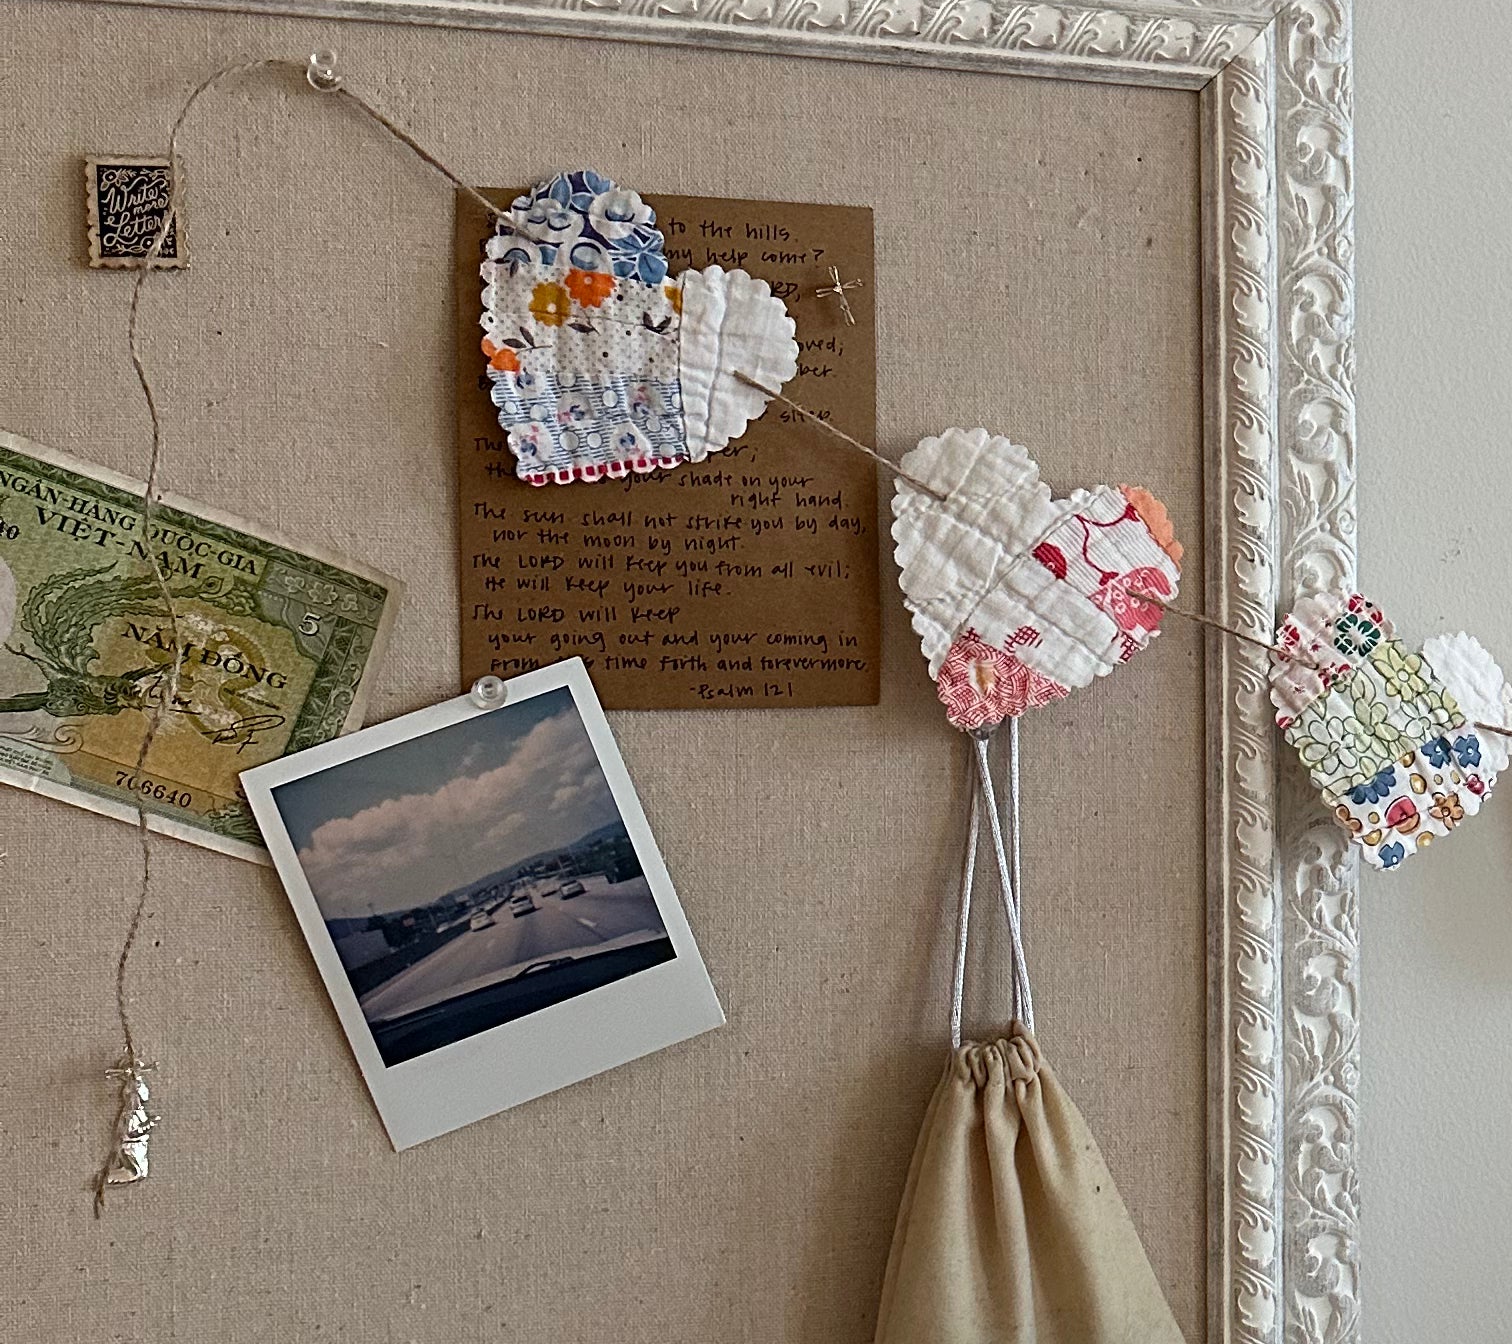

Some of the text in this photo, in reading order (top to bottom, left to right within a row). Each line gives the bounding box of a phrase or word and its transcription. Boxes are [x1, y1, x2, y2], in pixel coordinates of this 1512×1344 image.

[101, 176, 167, 213] Write
[134, 192, 168, 215] more
[669, 218, 798, 242] to the hills.
[707, 247, 748, 265] help
[761, 249, 824, 264] come?
[621, 470, 814, 495] your shade on your
[731, 490, 848, 510] right hand.
[474, 502, 866, 535] The sun shall not strike you by day,
[493, 529, 745, 556] nor the moon by night.
[473, 554, 501, 569] The
[519, 554, 564, 570] LORD
[578, 554, 613, 570] will
[676, 560, 708, 577] you
[716, 560, 762, 577] from
[771, 561, 793, 578] all
[804, 560, 850, 579] evil;
[485, 576, 506, 592] He
[517, 575, 550, 592] will
[623, 582, 674, 603] your
[688, 578, 731, 598] life.
[299, 612, 321, 636] 5
[473, 604, 503, 620] The
[517, 605, 564, 622] LORD
[579, 606, 617, 622] will
[488, 630, 857, 653] your going out and your coming in
[605, 656, 647, 670] time
[659, 655, 707, 671] forth
[717, 657, 753, 671] and
[760, 655, 869, 673] forevermore.
[765, 682, 793, 697] 121
